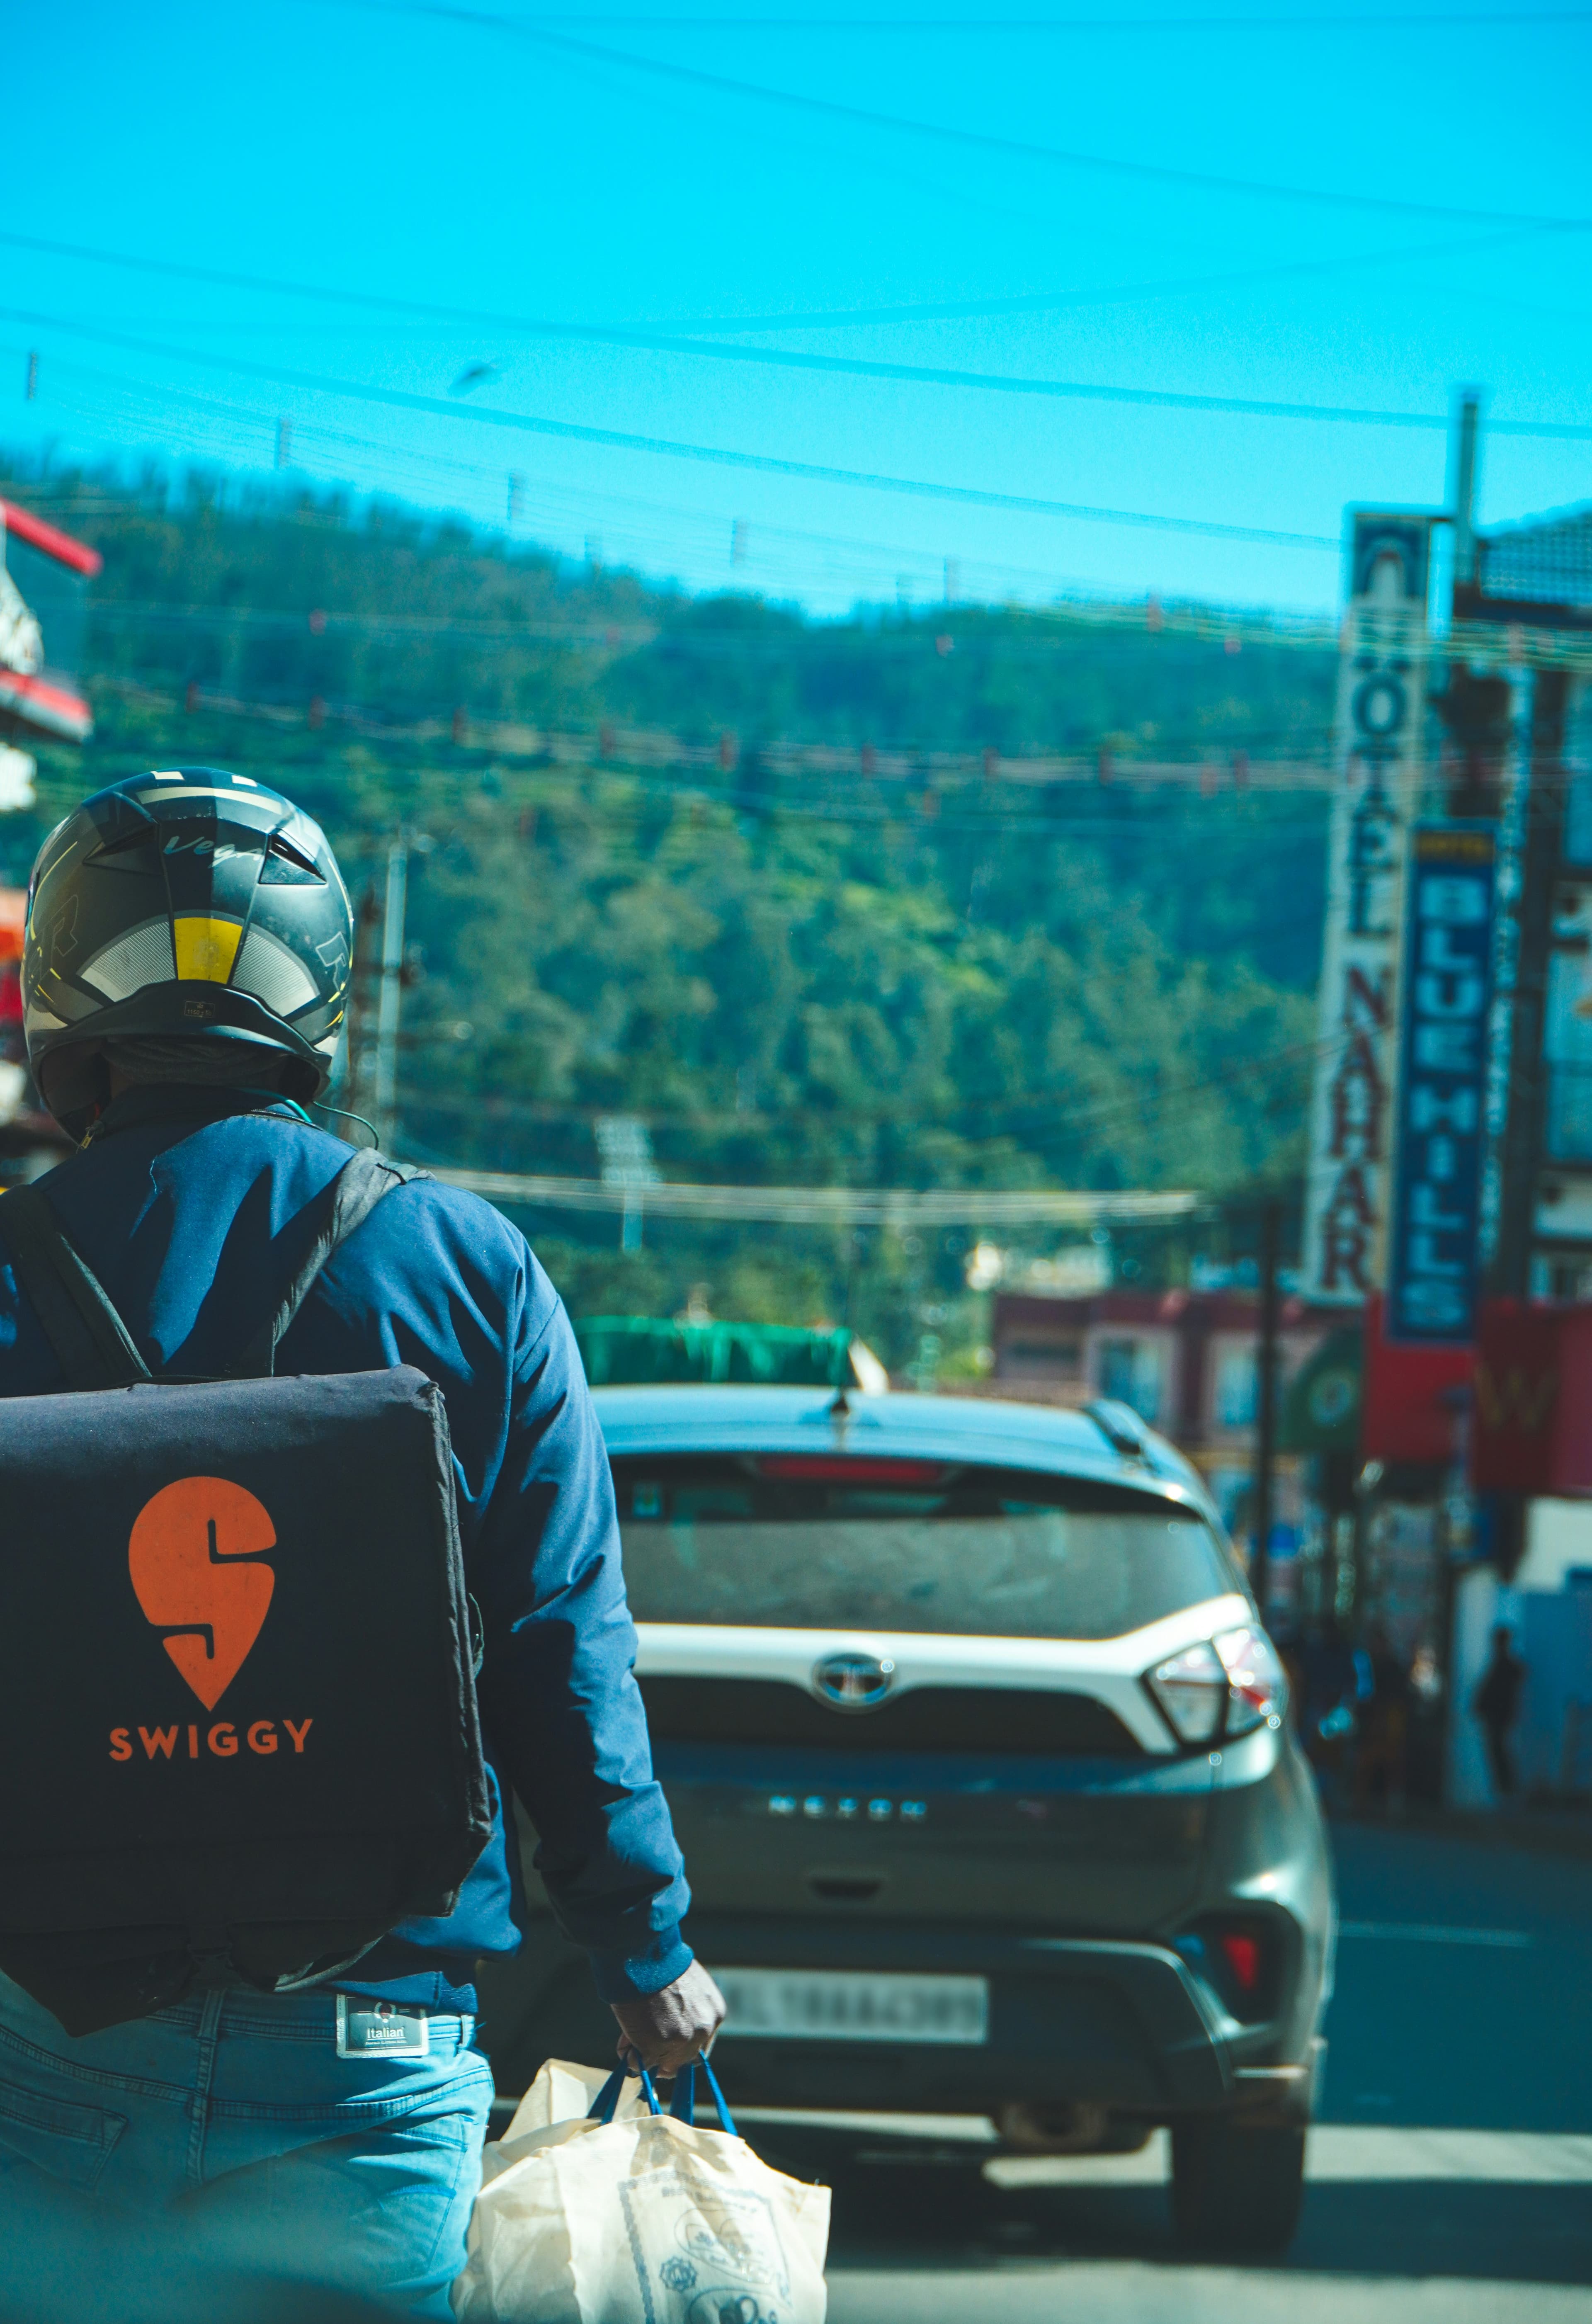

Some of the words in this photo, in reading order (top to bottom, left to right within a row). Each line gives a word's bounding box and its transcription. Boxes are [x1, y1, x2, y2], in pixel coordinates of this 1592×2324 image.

[1413, 873, 1489, 1071] BLUE
[1321, 963, 1392, 1291] NAHAR
[1401, 1083, 1478, 1326] HILLS
[109, 1719, 313, 1761] SWIGGY
[367, 2027, 404, 2038] Italian
